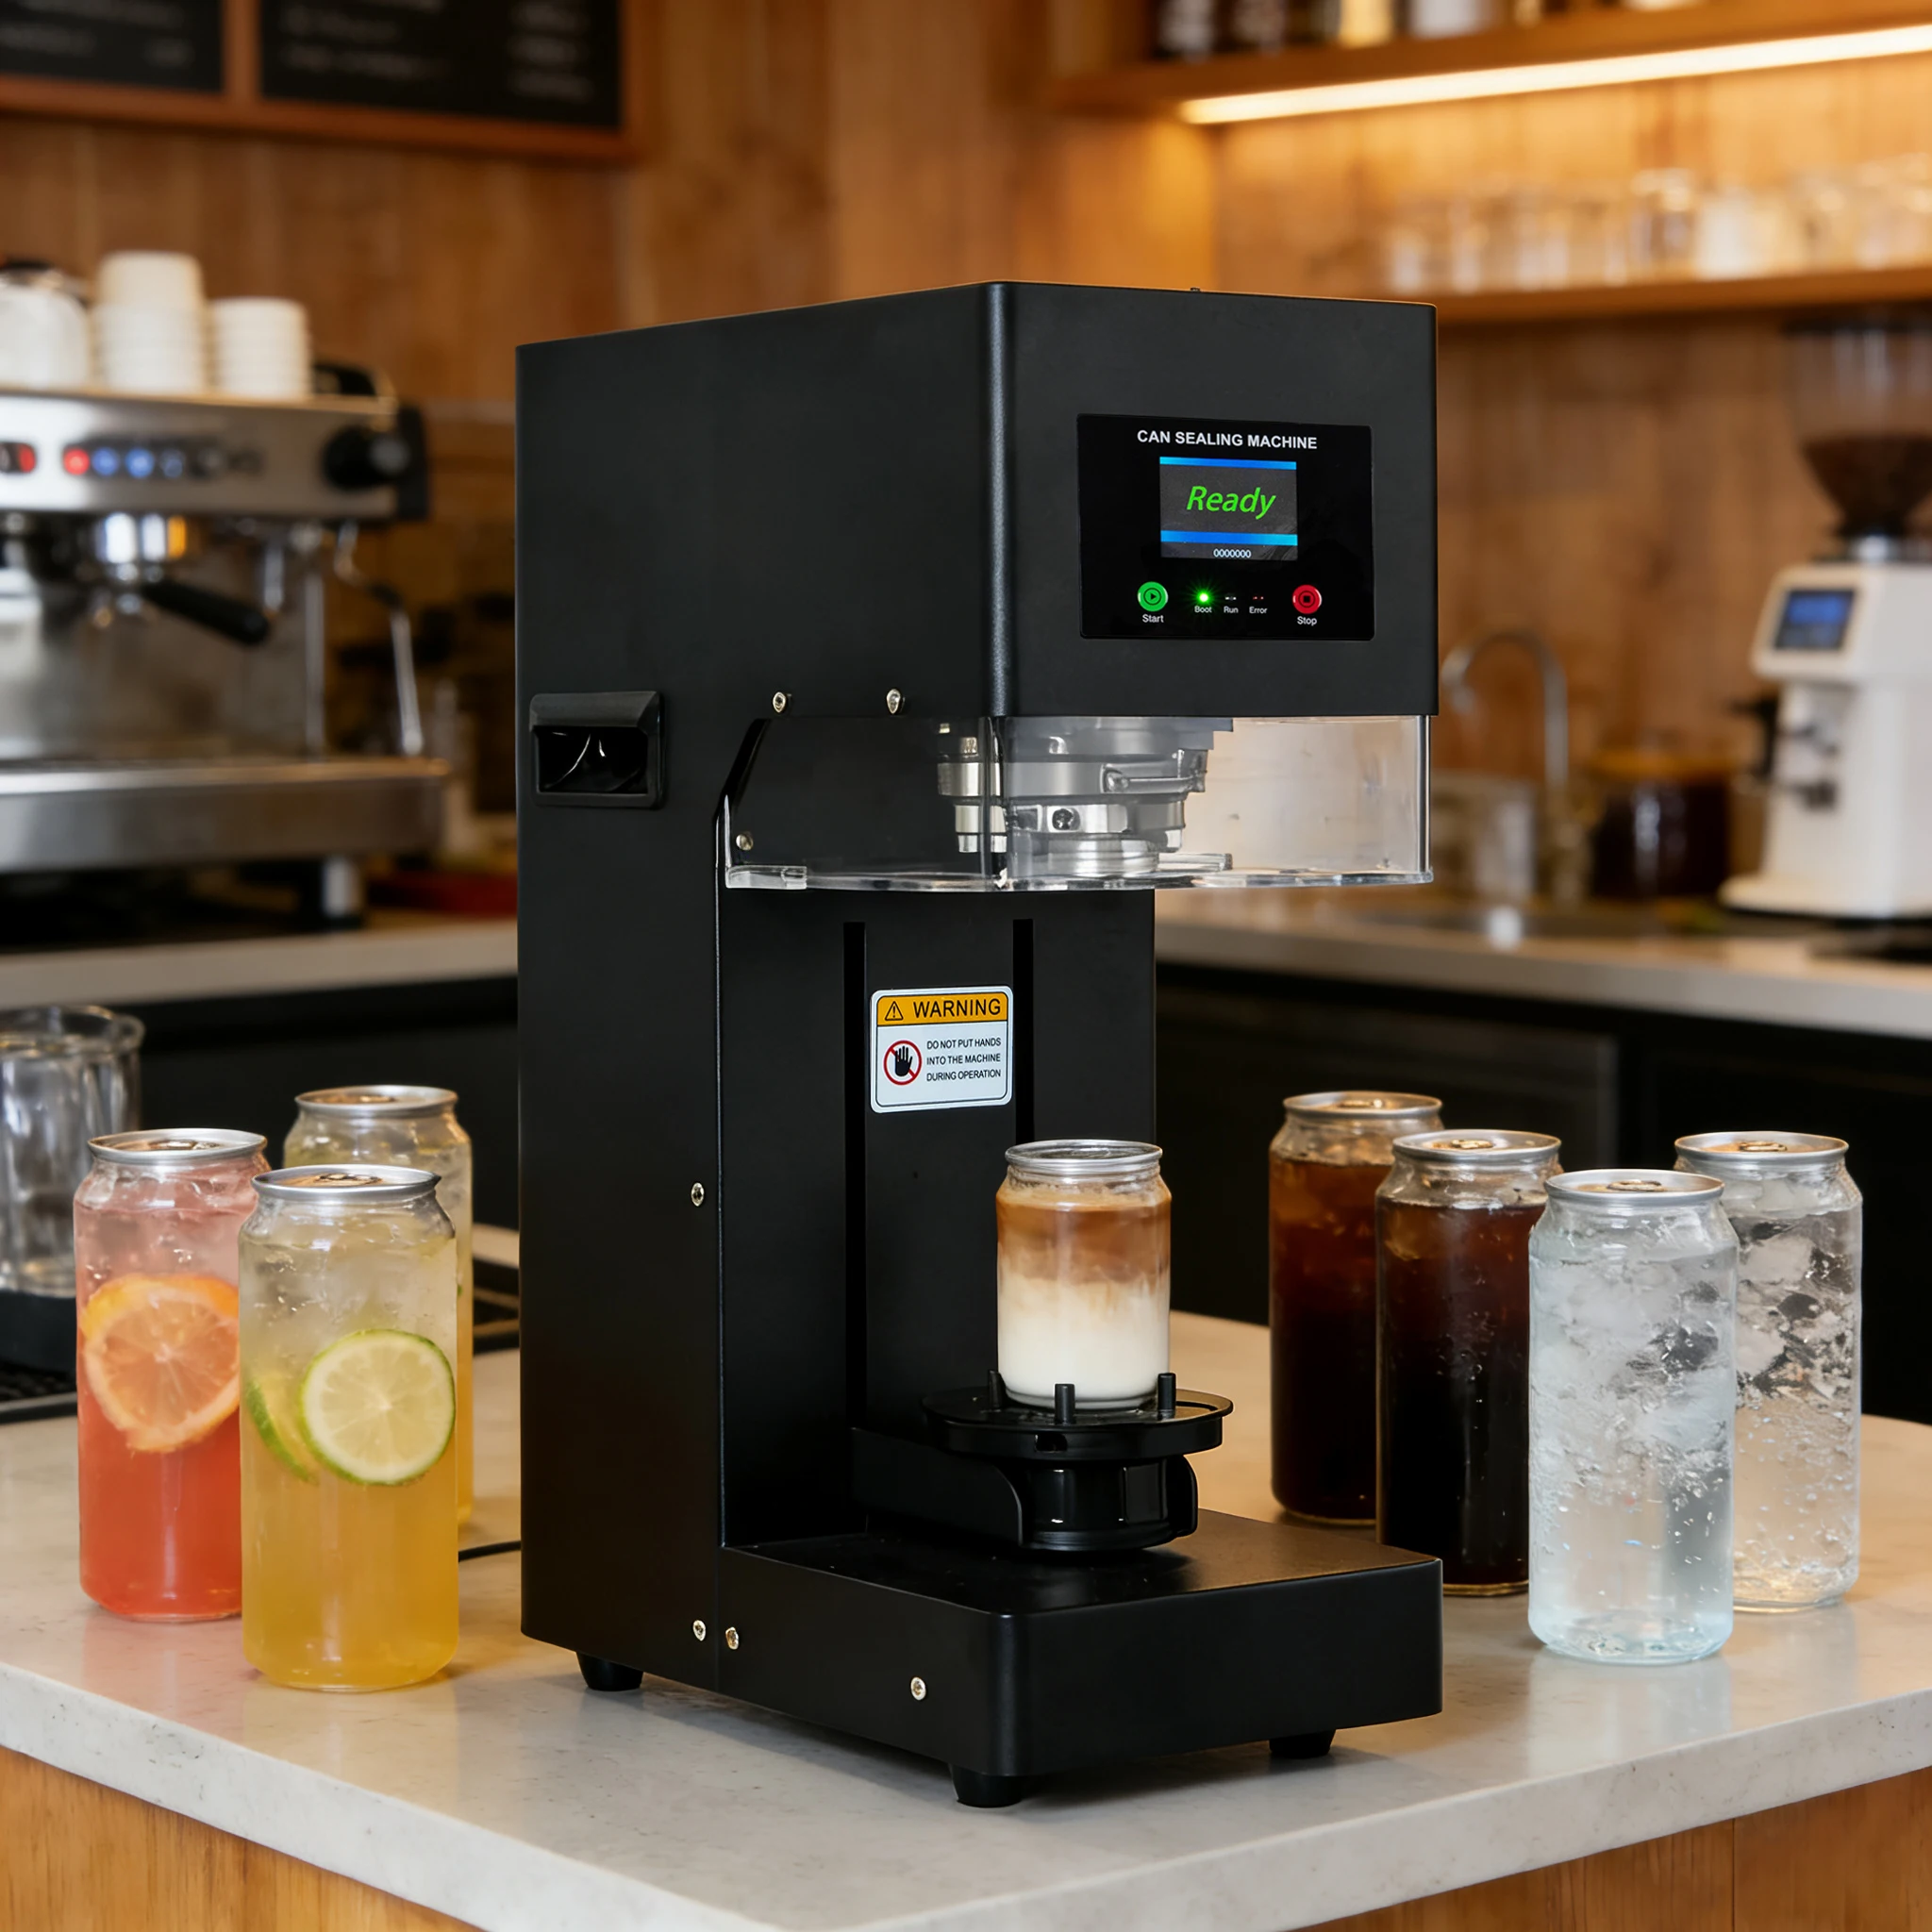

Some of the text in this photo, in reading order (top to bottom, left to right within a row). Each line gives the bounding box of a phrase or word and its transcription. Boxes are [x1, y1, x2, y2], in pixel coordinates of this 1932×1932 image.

[1137, 430, 1317, 449] CAN SEALING MACHINE
[1186, 485, 1276, 520] Ready
[1194, 605, 1212, 613] Boot
[1224, 606, 1239, 614] Run
[1249, 606, 1268, 614] Error
[1141, 614, 1164, 624] Start
[1297, 616, 1318, 626] Stop
[913, 998, 1001, 1018] WARNING
[926, 1037, 1002, 1050] DO NOT PUT HANDS
[926, 1053, 1001, 1065] INTO THE MACHINE
[926, 1069, 1001, 1082] DURING OPERATION
